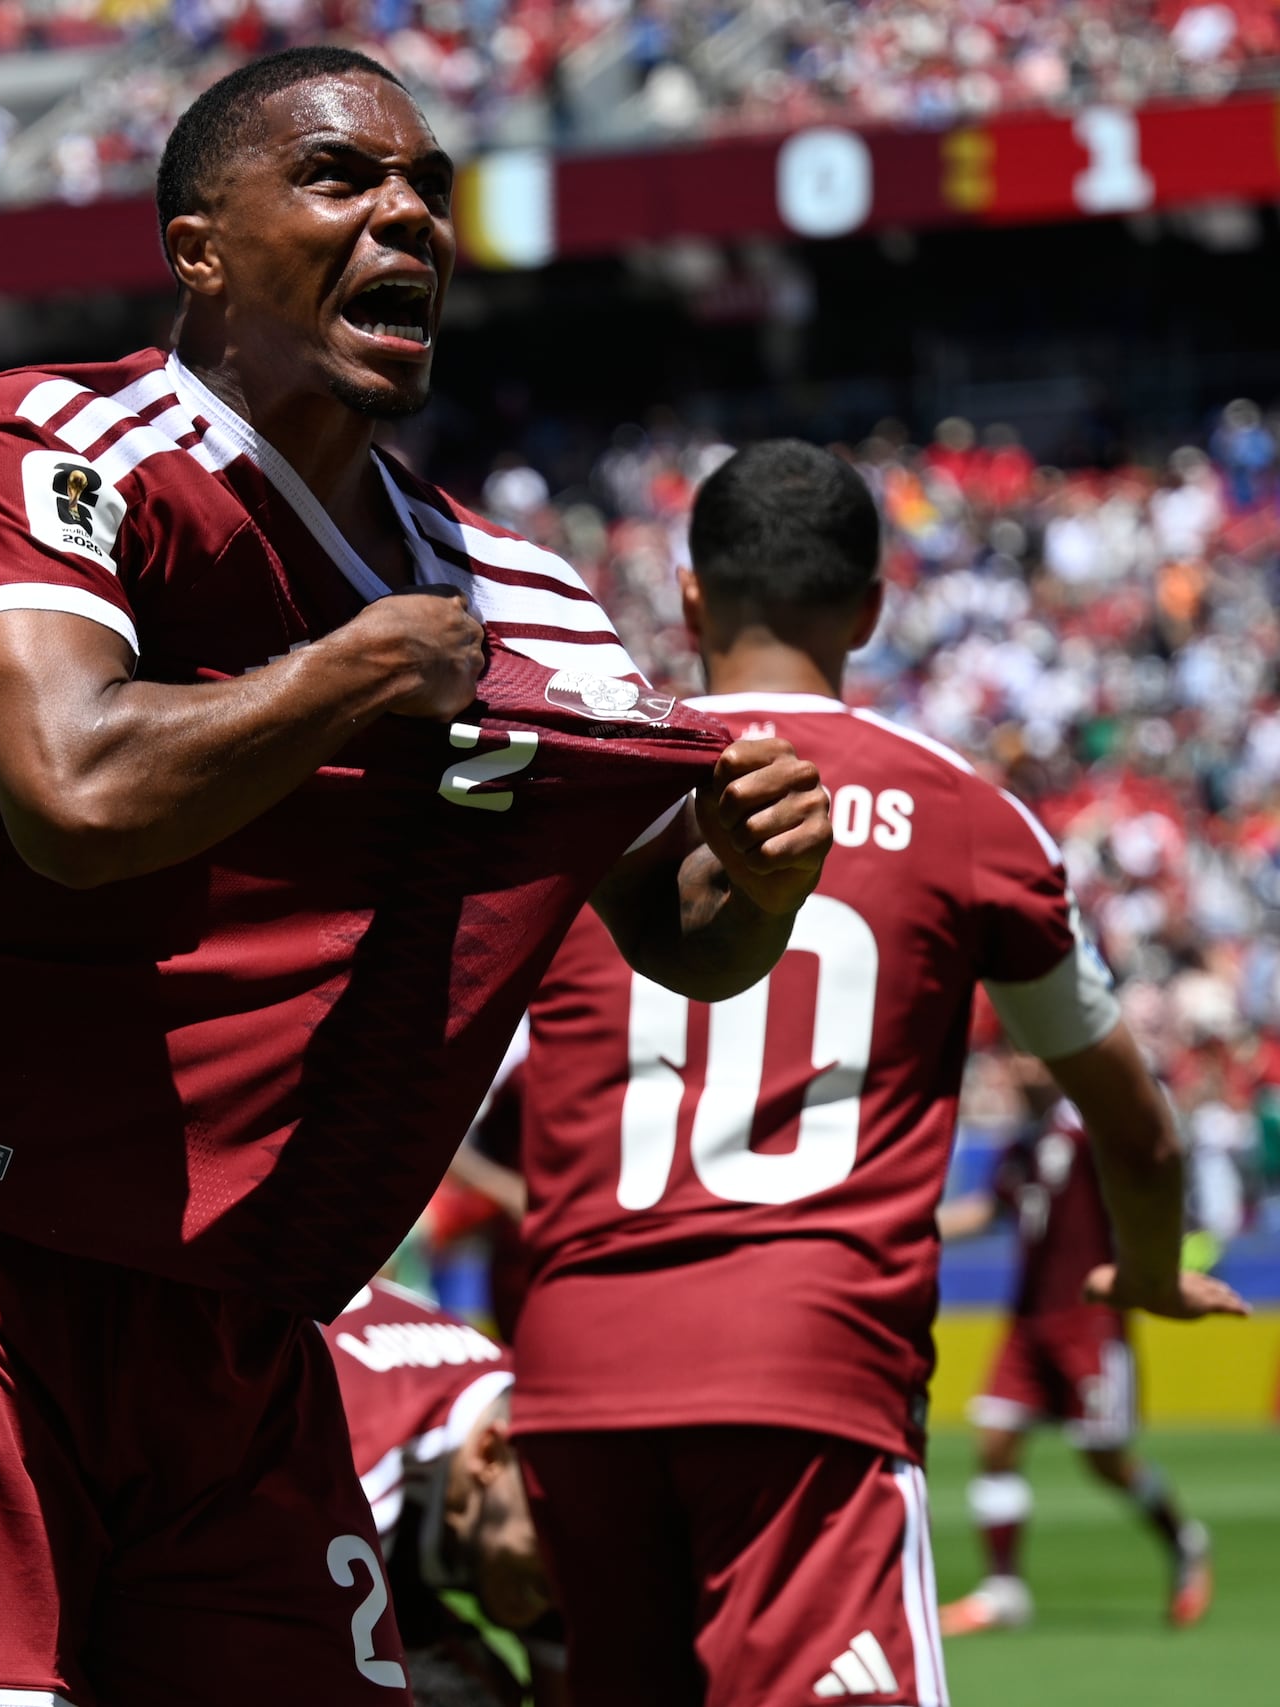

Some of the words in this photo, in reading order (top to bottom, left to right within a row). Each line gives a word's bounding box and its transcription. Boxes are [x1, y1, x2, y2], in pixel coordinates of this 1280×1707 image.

[775, 125, 874, 238] 0
[1071, 105, 1155, 215] 1
[437, 723, 539, 812] 2
[617, 893, 878, 1210] 10
[327, 1535, 406, 1688] 2
